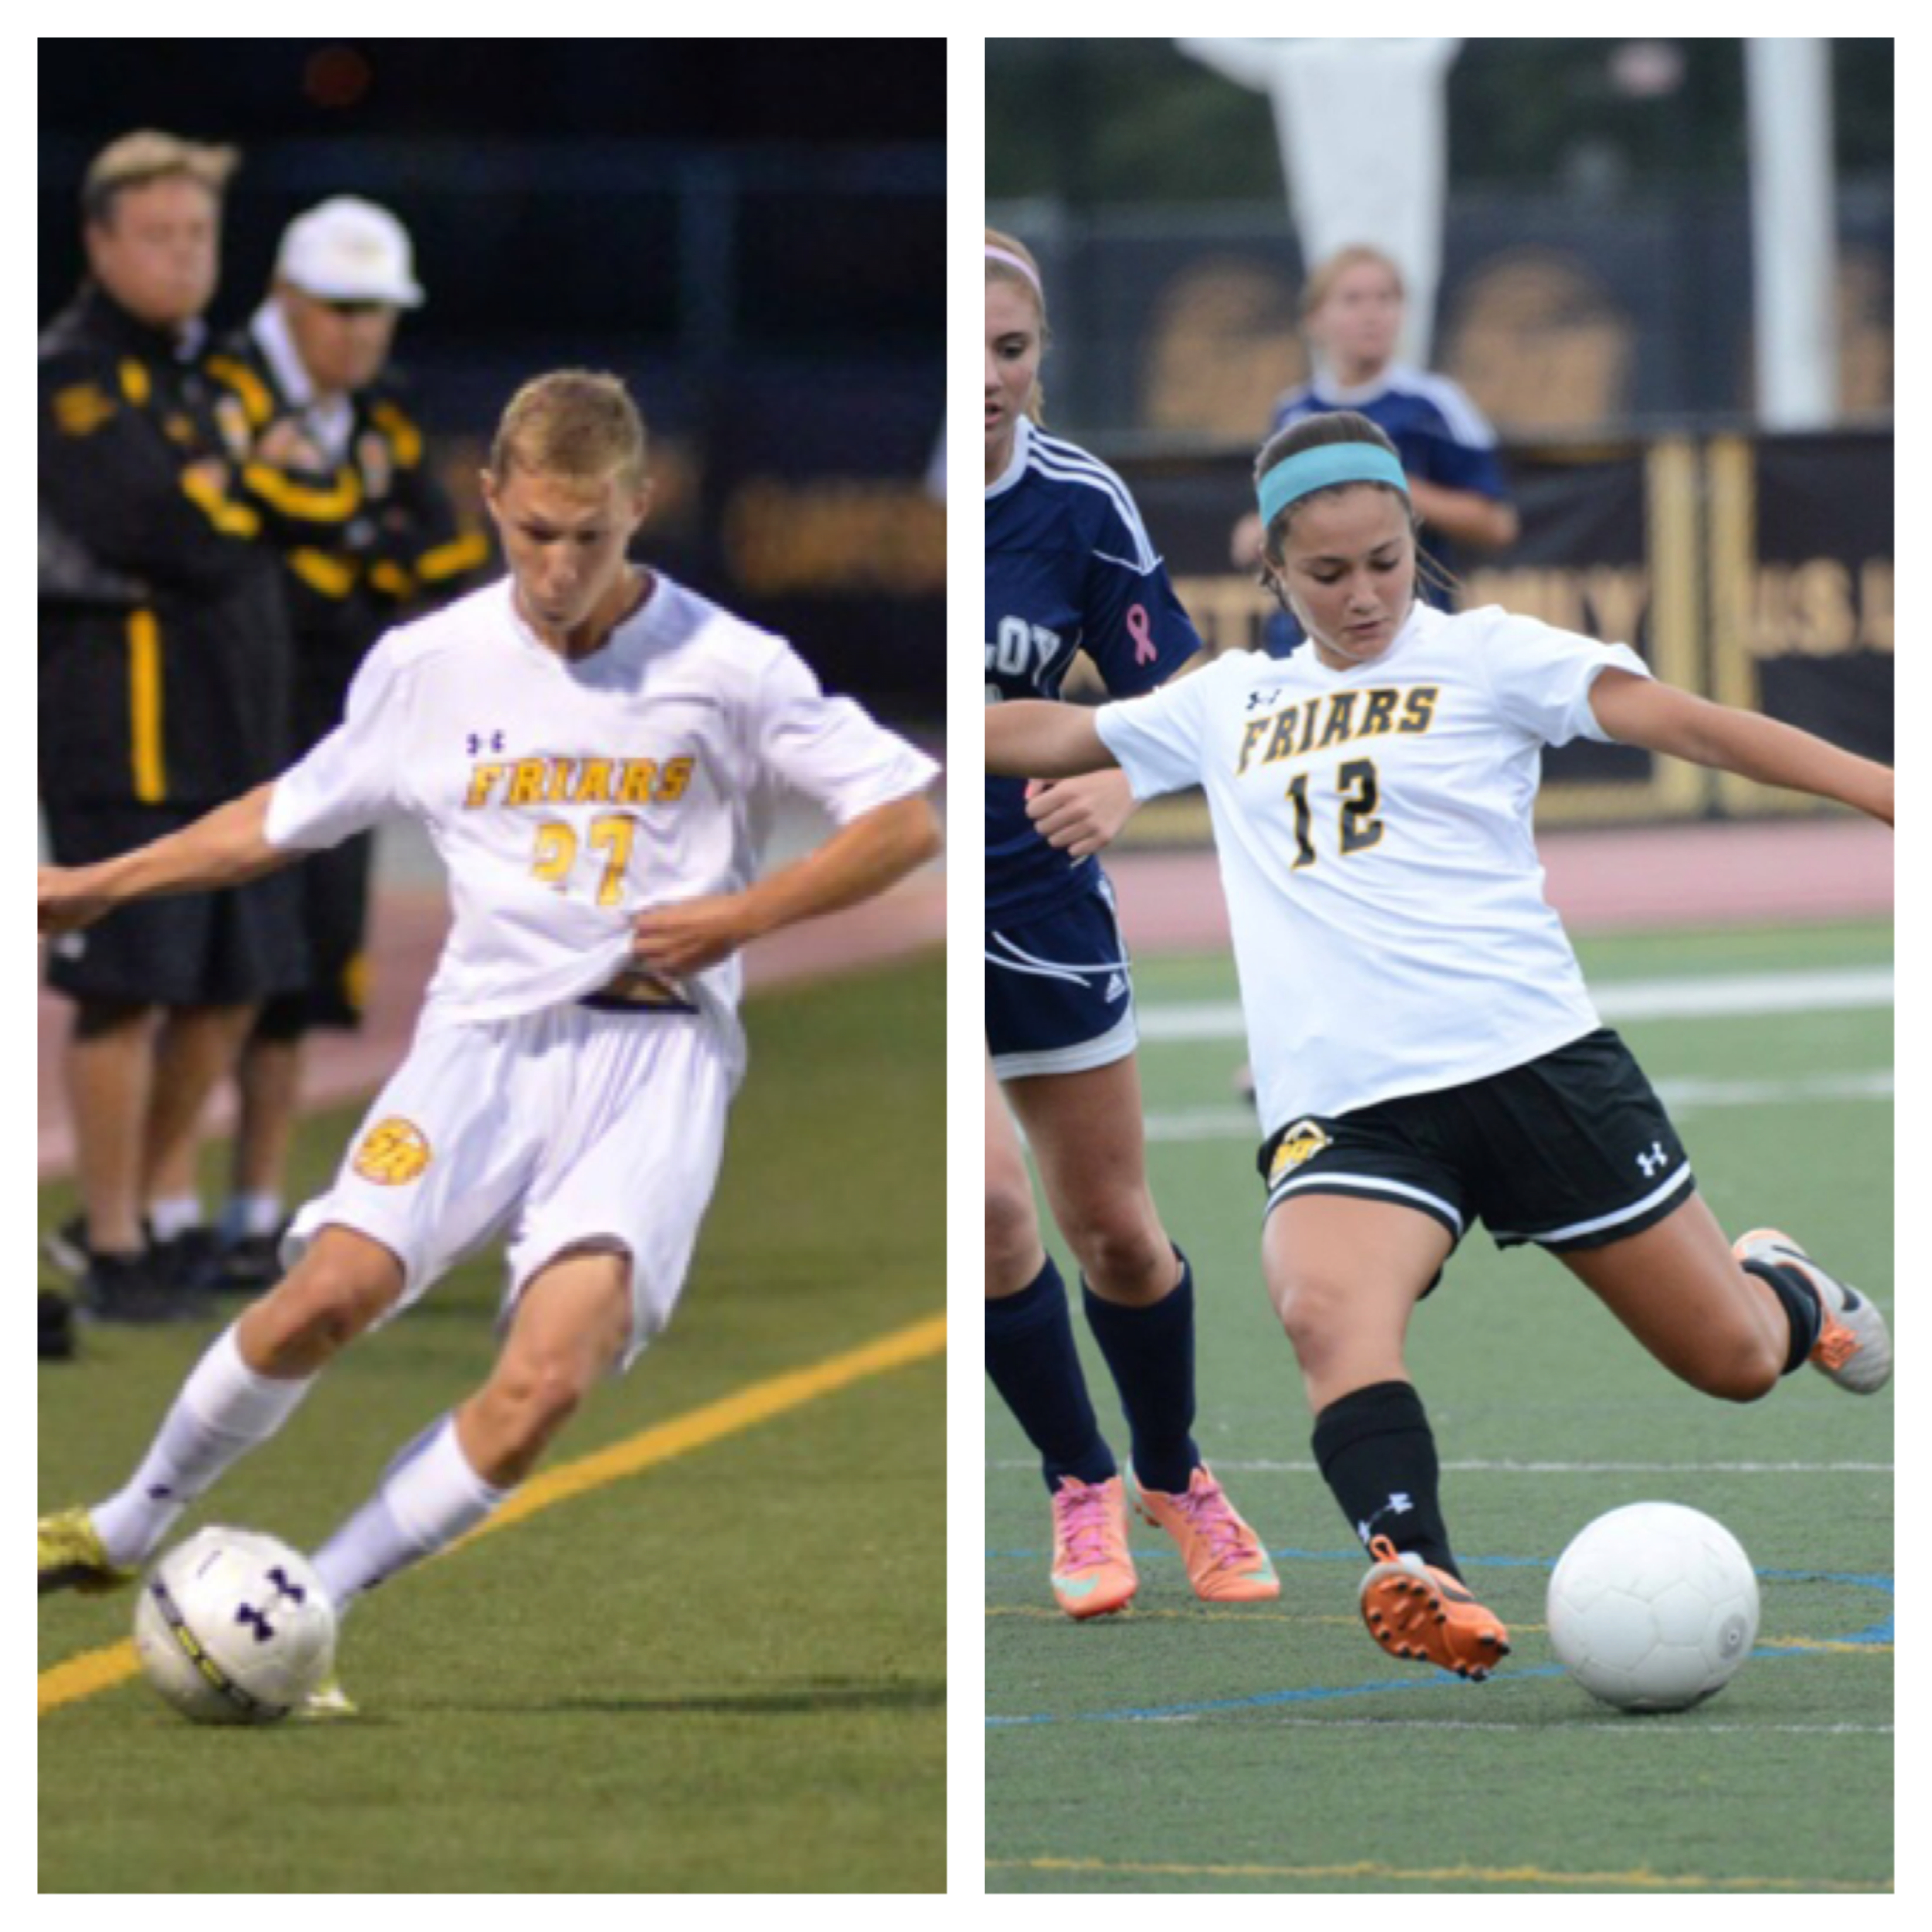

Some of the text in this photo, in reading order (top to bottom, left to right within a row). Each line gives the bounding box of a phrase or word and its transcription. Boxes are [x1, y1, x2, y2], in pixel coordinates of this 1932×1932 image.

[1235, 686, 1439, 777] FRIARS
[464, 755, 696, 807] FRIARS
[1285, 757, 1384, 872] 12
